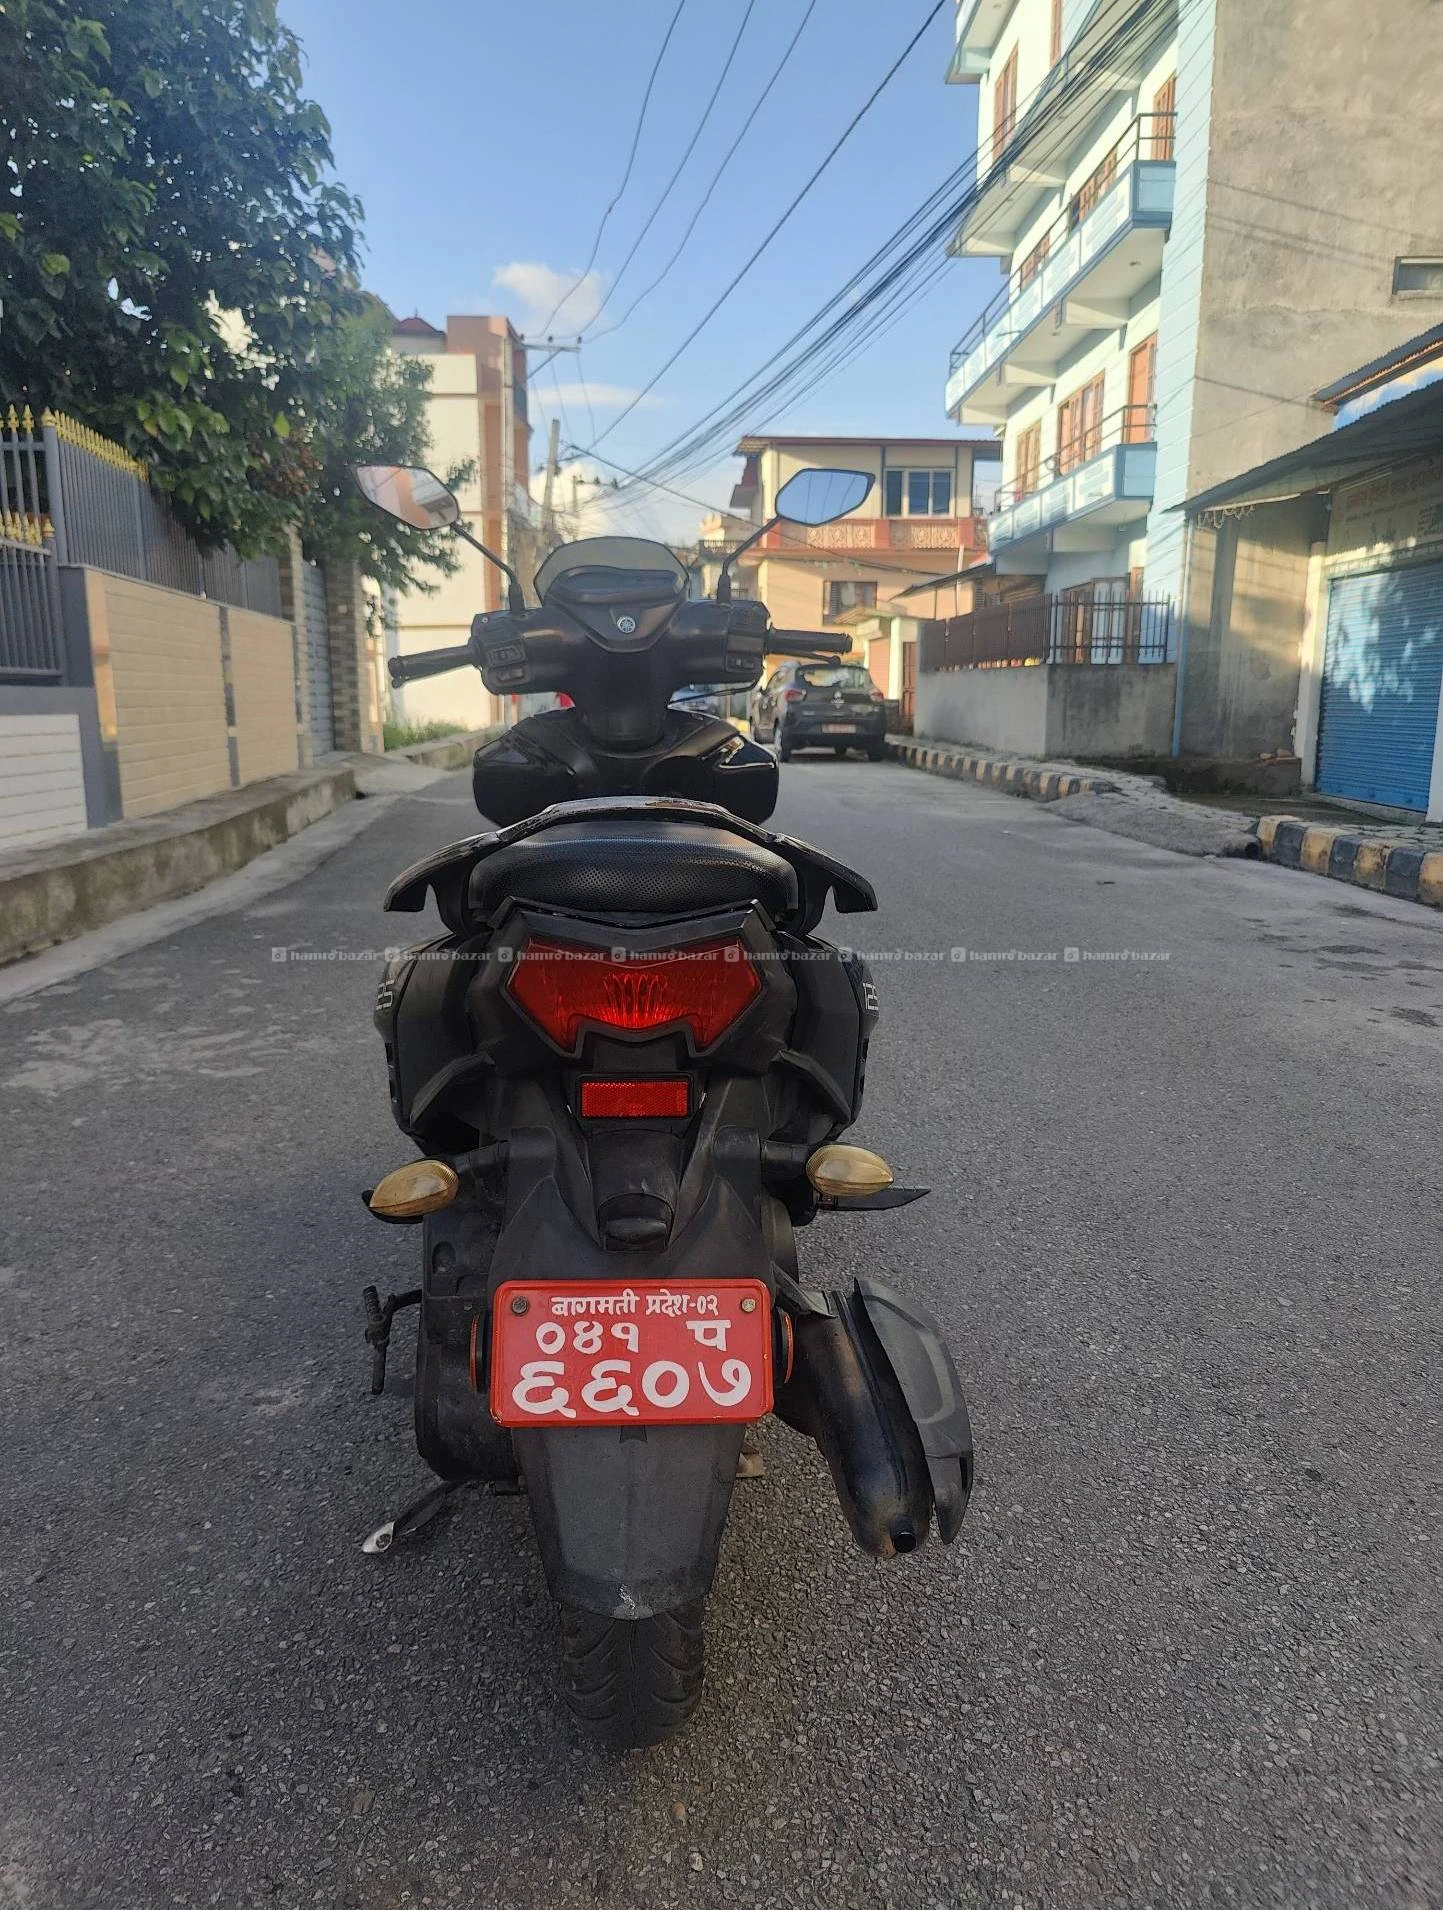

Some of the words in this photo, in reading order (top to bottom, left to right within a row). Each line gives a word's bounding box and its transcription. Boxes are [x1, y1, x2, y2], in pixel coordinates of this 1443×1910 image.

[551, 1288, 640, 1317] बागमती
[535, 1320, 639, 1355] ०४१
[686, 1319, 731, 1352] प
[512, 1358, 752, 1419] ६६०७
